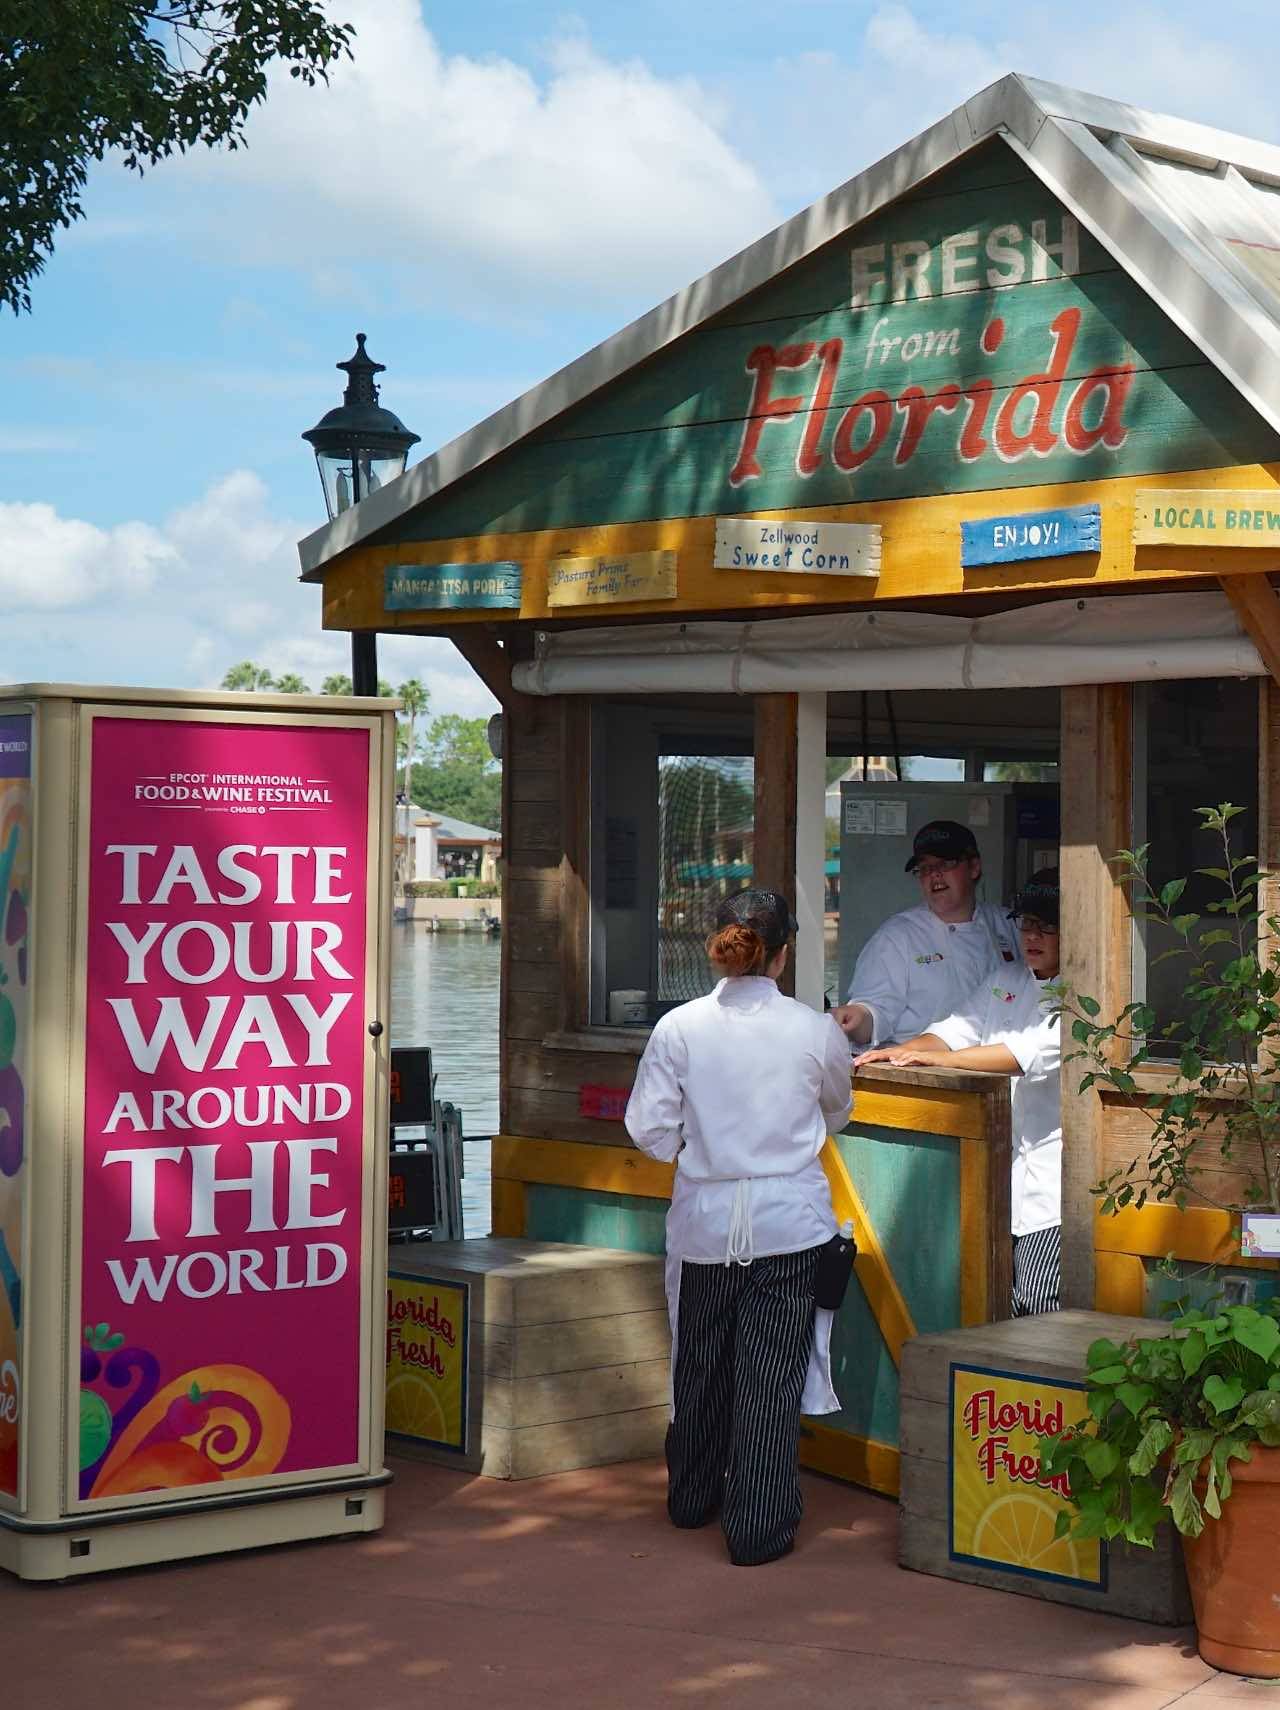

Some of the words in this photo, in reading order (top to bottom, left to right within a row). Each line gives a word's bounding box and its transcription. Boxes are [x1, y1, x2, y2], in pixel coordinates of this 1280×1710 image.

[850, 216, 1080, 313] FRESH
[866, 317, 961, 369] from
[729, 308, 1136, 488] Florida
[760, 528, 818, 545] Zellwood
[994, 522, 1060, 547] ENJOY!
[1154, 507, 1217, 529] LOCAL
[733, 546, 793, 567] Sweet
[802, 548, 849, 568] Corn
[213, 774, 303, 786] INTERNATIONAL
[258, 788, 333, 803] FESTIVAL
[105, 844, 352, 906] TASTE
[105, 920, 354, 985] YOUR
[106, 993, 354, 1074] WAY
[101, 1082, 352, 1134] AROUND
[101, 1137, 347, 1244] THE
[104, 1242, 348, 1305] WORLD
[386, 1289, 456, 1347] lorida
[963, 1389, 1073, 1442] Florid
